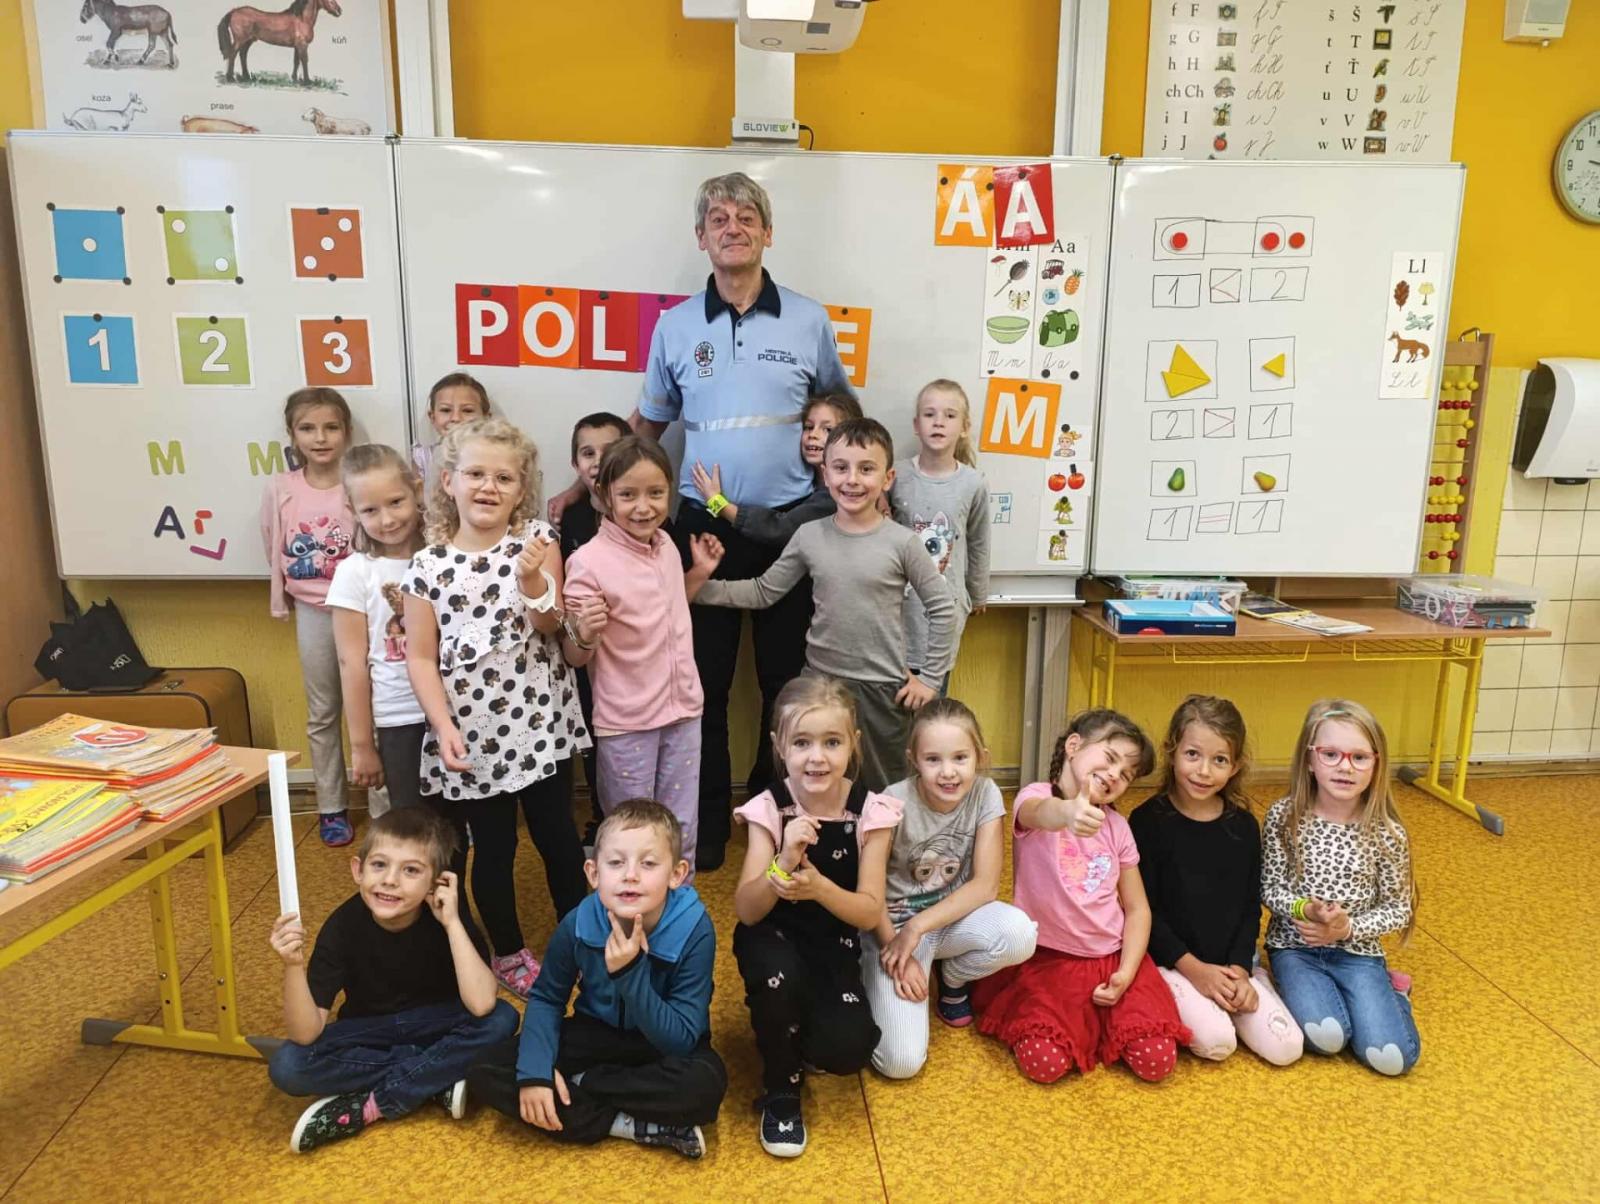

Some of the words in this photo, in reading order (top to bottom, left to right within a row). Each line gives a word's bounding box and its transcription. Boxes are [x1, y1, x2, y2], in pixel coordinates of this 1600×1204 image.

[1172, 3, 1177, 16] f
[1190, 3, 1200, 17] F
[1352, 6, 1361, 22] Š
[1169, 34, 1177, 45] g
[1188, 30, 1200, 44] G
[1327, 36, 1332, 48] t
[1350, 34, 1362, 48] T
[1168, 57, 1176, 70] h
[1187, 57, 1200, 70] H
[1348, 58, 1360, 74] Ť
[1166, 84, 1180, 98] ch
[1184, 84, 1204, 98] Ch
[1322, 90, 1331, 101] u
[1346, 88, 1359, 102] U
[210, 102, 234, 110] prase
[1164, 111, 1169, 124] i
[1320, 117, 1328, 126] v
[1344, 114, 1356, 126] V
[743, 122, 788, 132] GLOVIEW
[1588, 125, 1596, 136] 11
[1162, 135, 1168, 150] j
[1180, 135, 1187, 150] J
[1318, 140, 1328, 150] w
[1342, 138, 1357, 150] W
[1576, 139, 1584, 150] 10
[940, 168, 987, 238] Á
[1001, 180, 1048, 238] A
[1168, 277, 1180, 305] 1
[1270, 270, 1288, 300] 2
[88, 328, 112, 371] 1
[199, 330, 230, 372] 2
[322, 332, 352, 374] 3
[758, 354, 798, 365] POLICIE
[989, 392, 1048, 449] M
[1165, 410, 1182, 440] 2
[1262, 406, 1278, 438] 1
[147, 440, 185, 476] M
[154, 506, 186, 540] A
[1164, 509, 1178, 536] 1
[1252, 501, 1268, 531] 1
